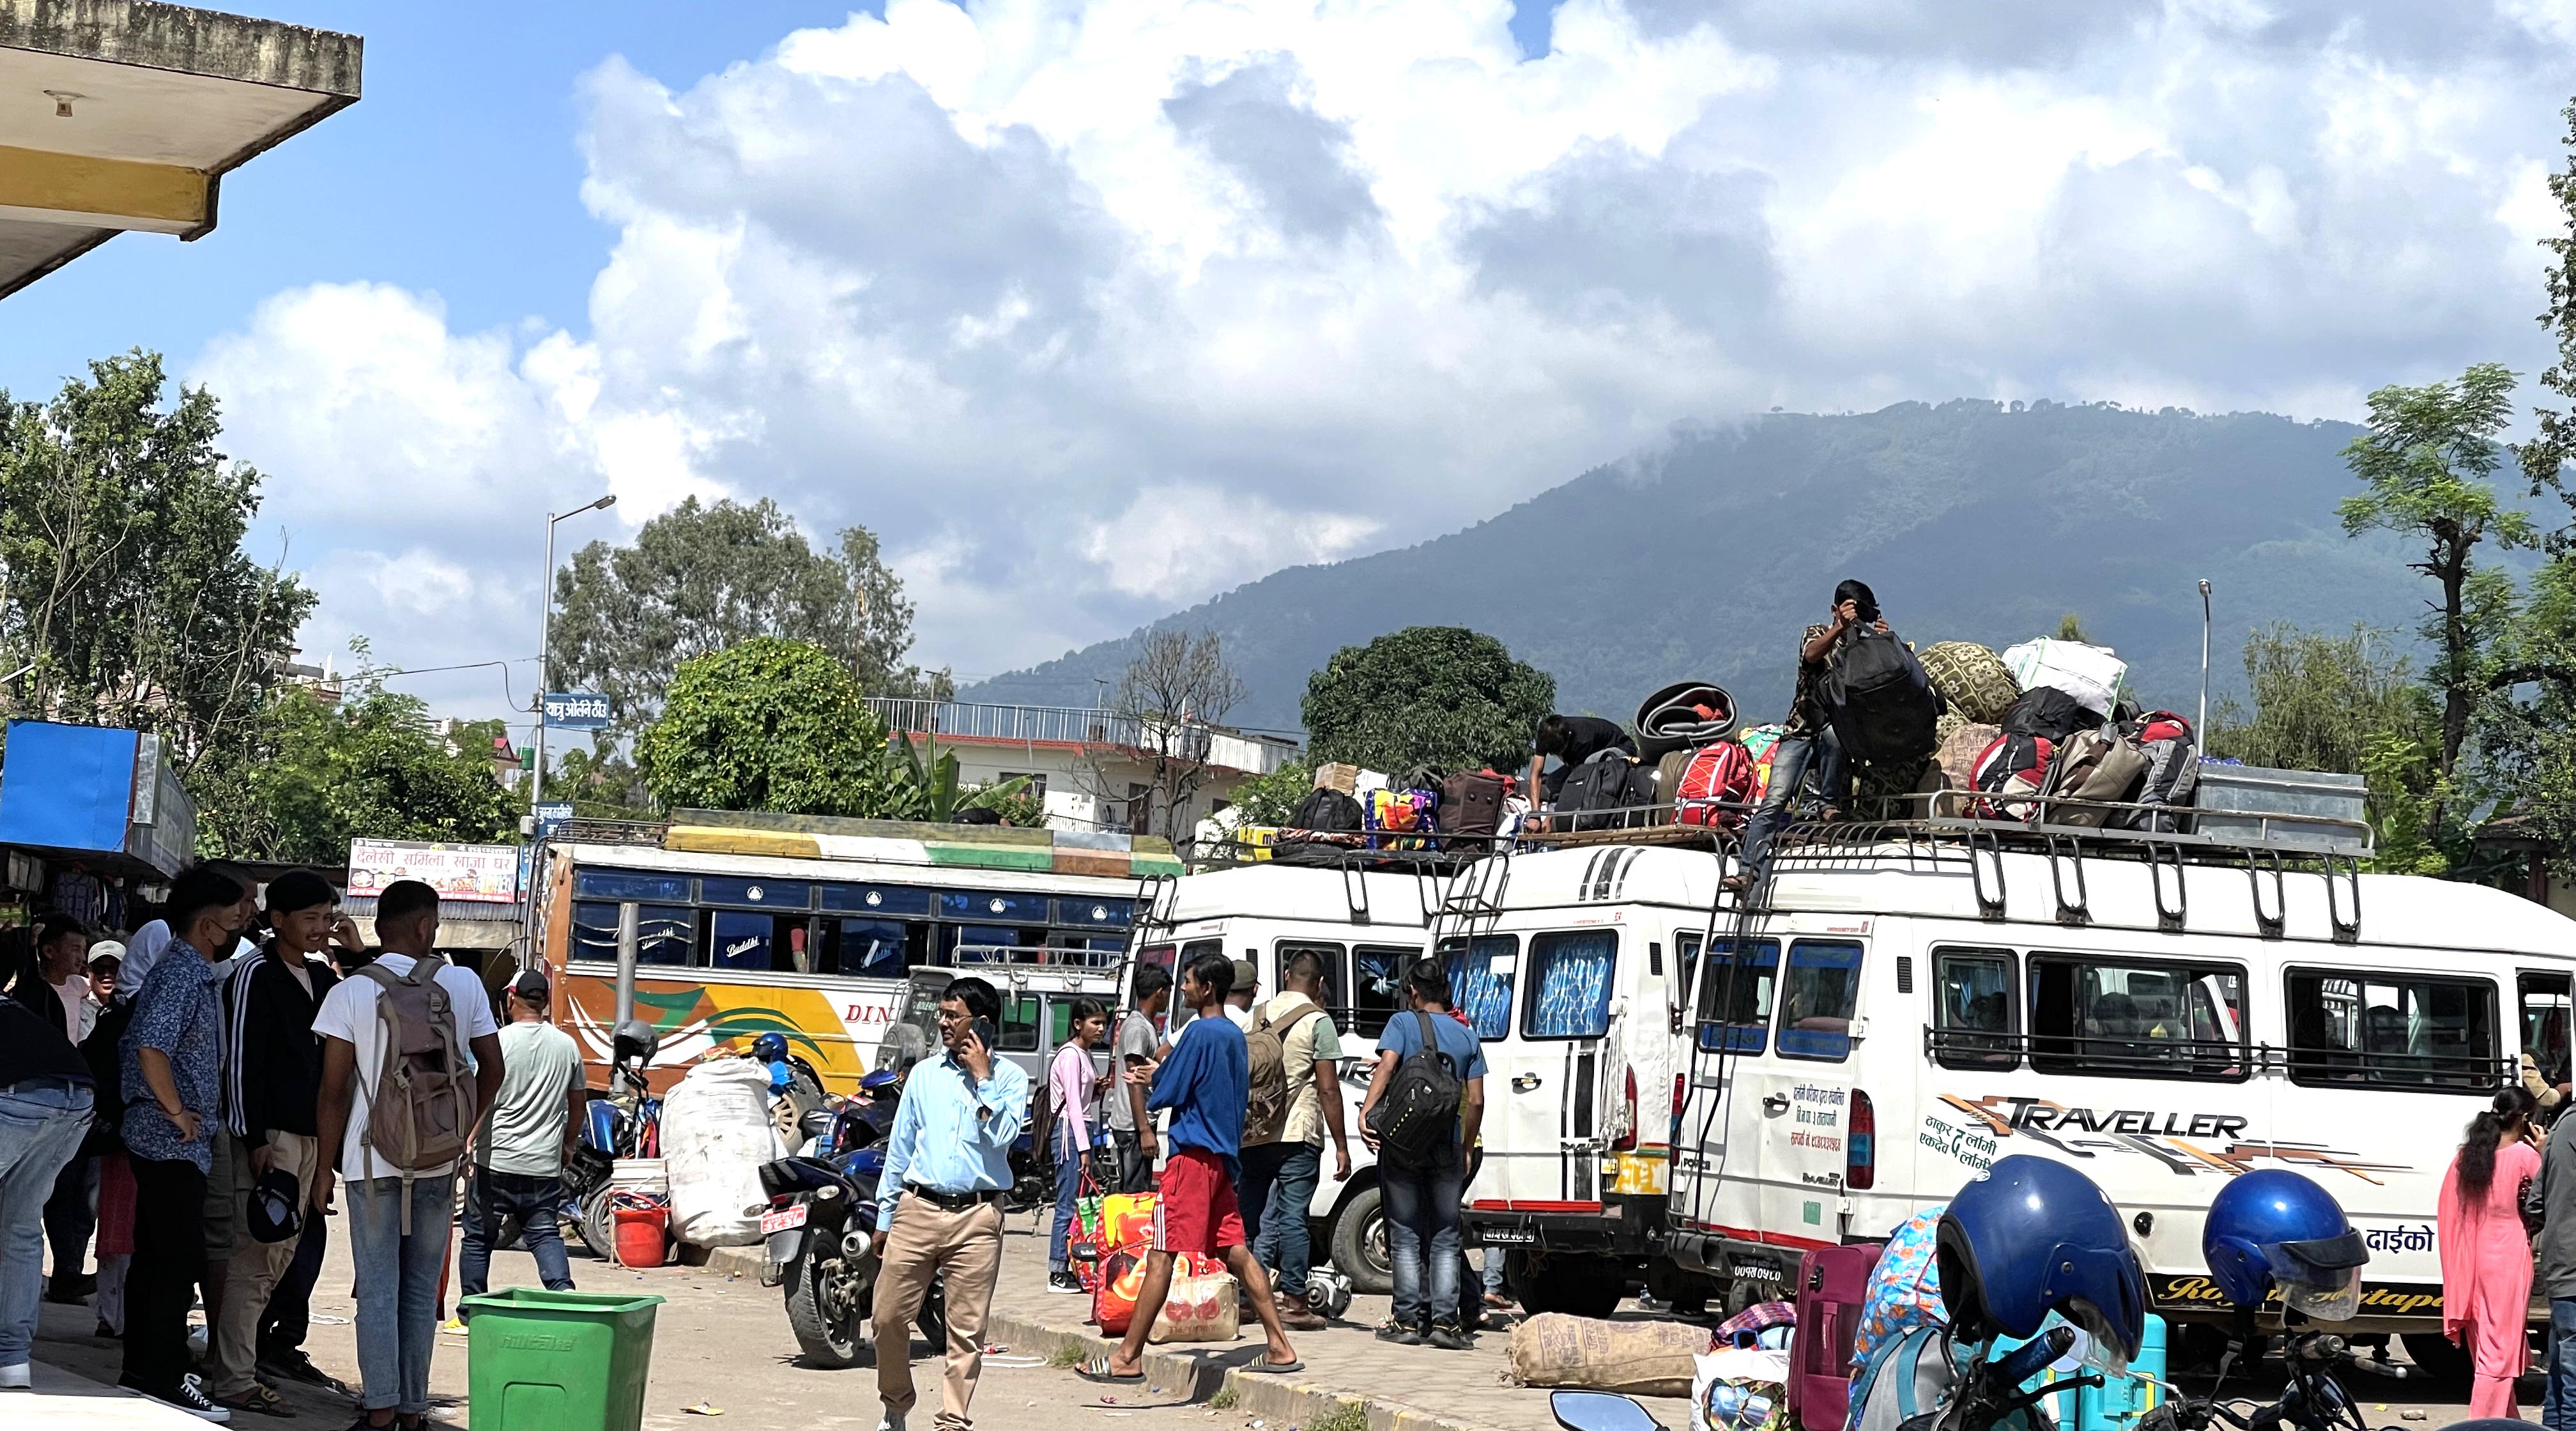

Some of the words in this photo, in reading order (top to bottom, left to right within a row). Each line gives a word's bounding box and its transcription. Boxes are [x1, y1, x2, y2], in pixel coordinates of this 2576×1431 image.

[546, 701, 564, 721] यात्रु
[454, 856, 486, 869] खाजा
[494, 858, 511, 870] घर
[1926, 1115, 1954, 1136] ठाकुर
[2007, 1097, 2248, 1139] TRAVELLER
[1920, 1133, 1949, 1154] एकदेव
[2366, 1225, 2435, 1253] दाईको
